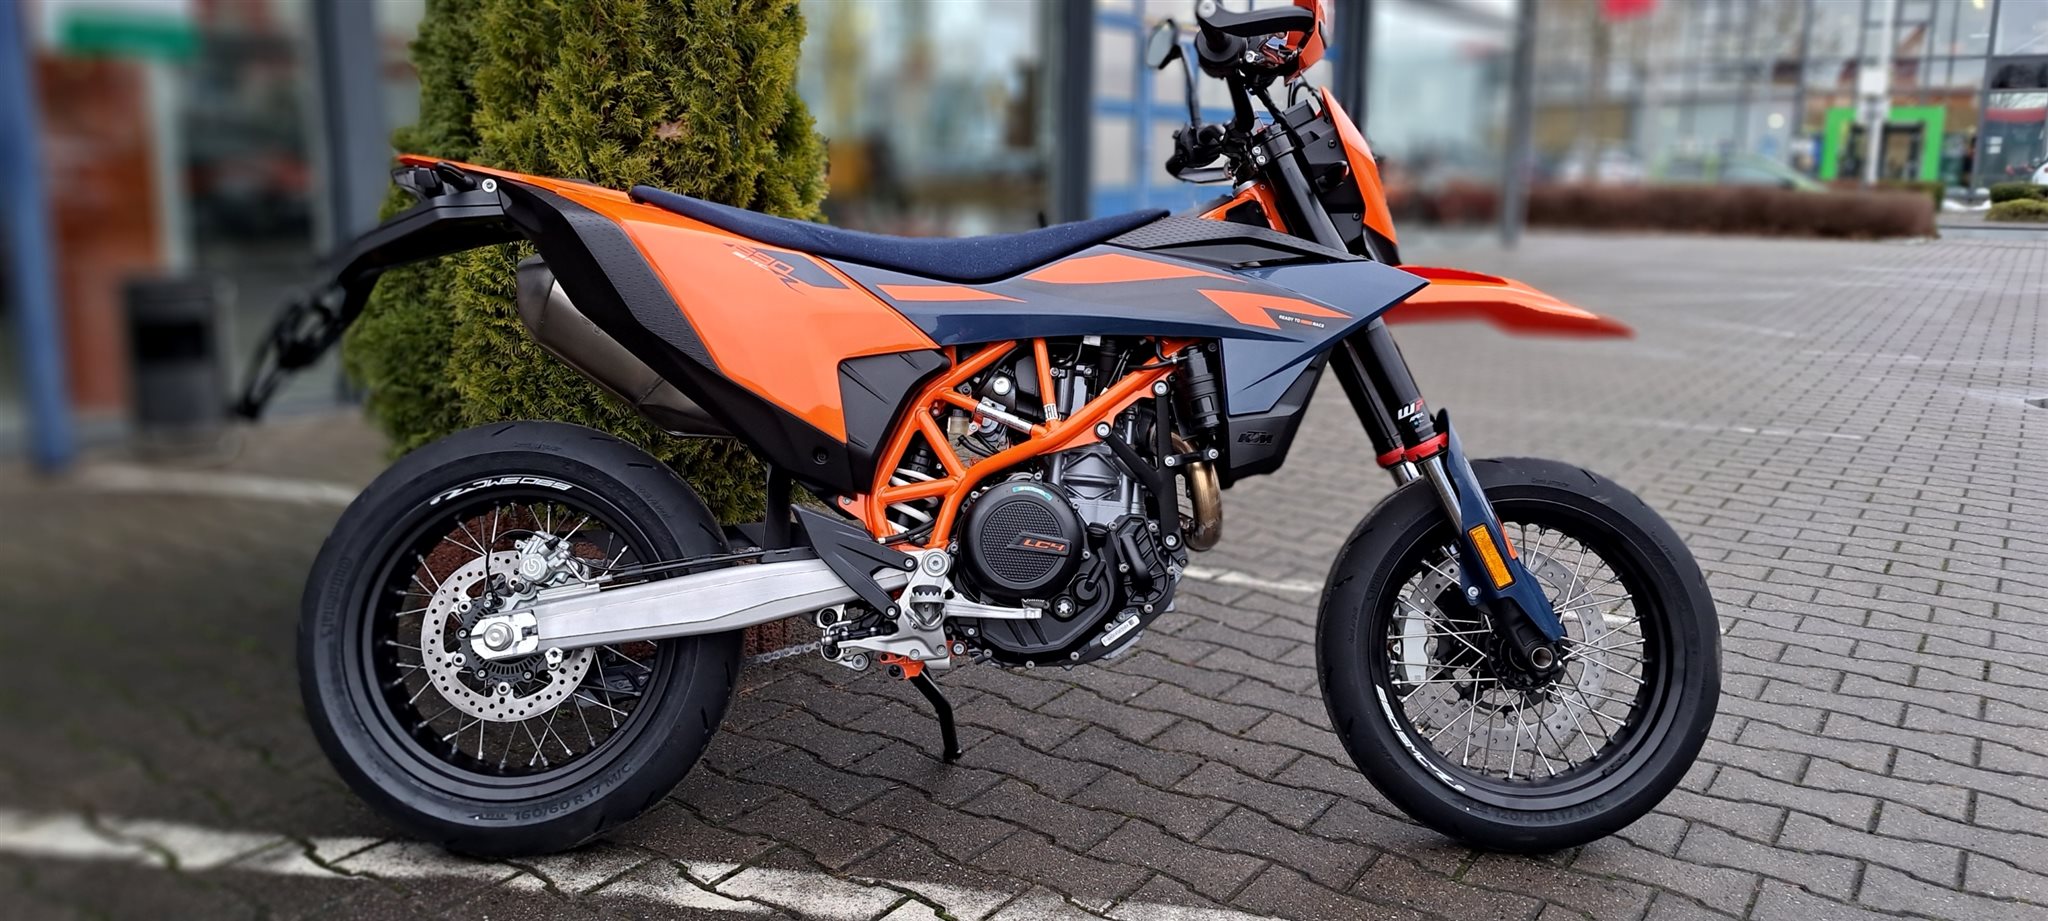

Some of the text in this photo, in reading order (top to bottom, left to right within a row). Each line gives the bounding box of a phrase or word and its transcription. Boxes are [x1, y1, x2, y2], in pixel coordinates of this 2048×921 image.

[1237, 430, 1273, 444] KTM
[1023, 538, 1066, 551] LC4
[513, 800, 570, 821] 160/60
